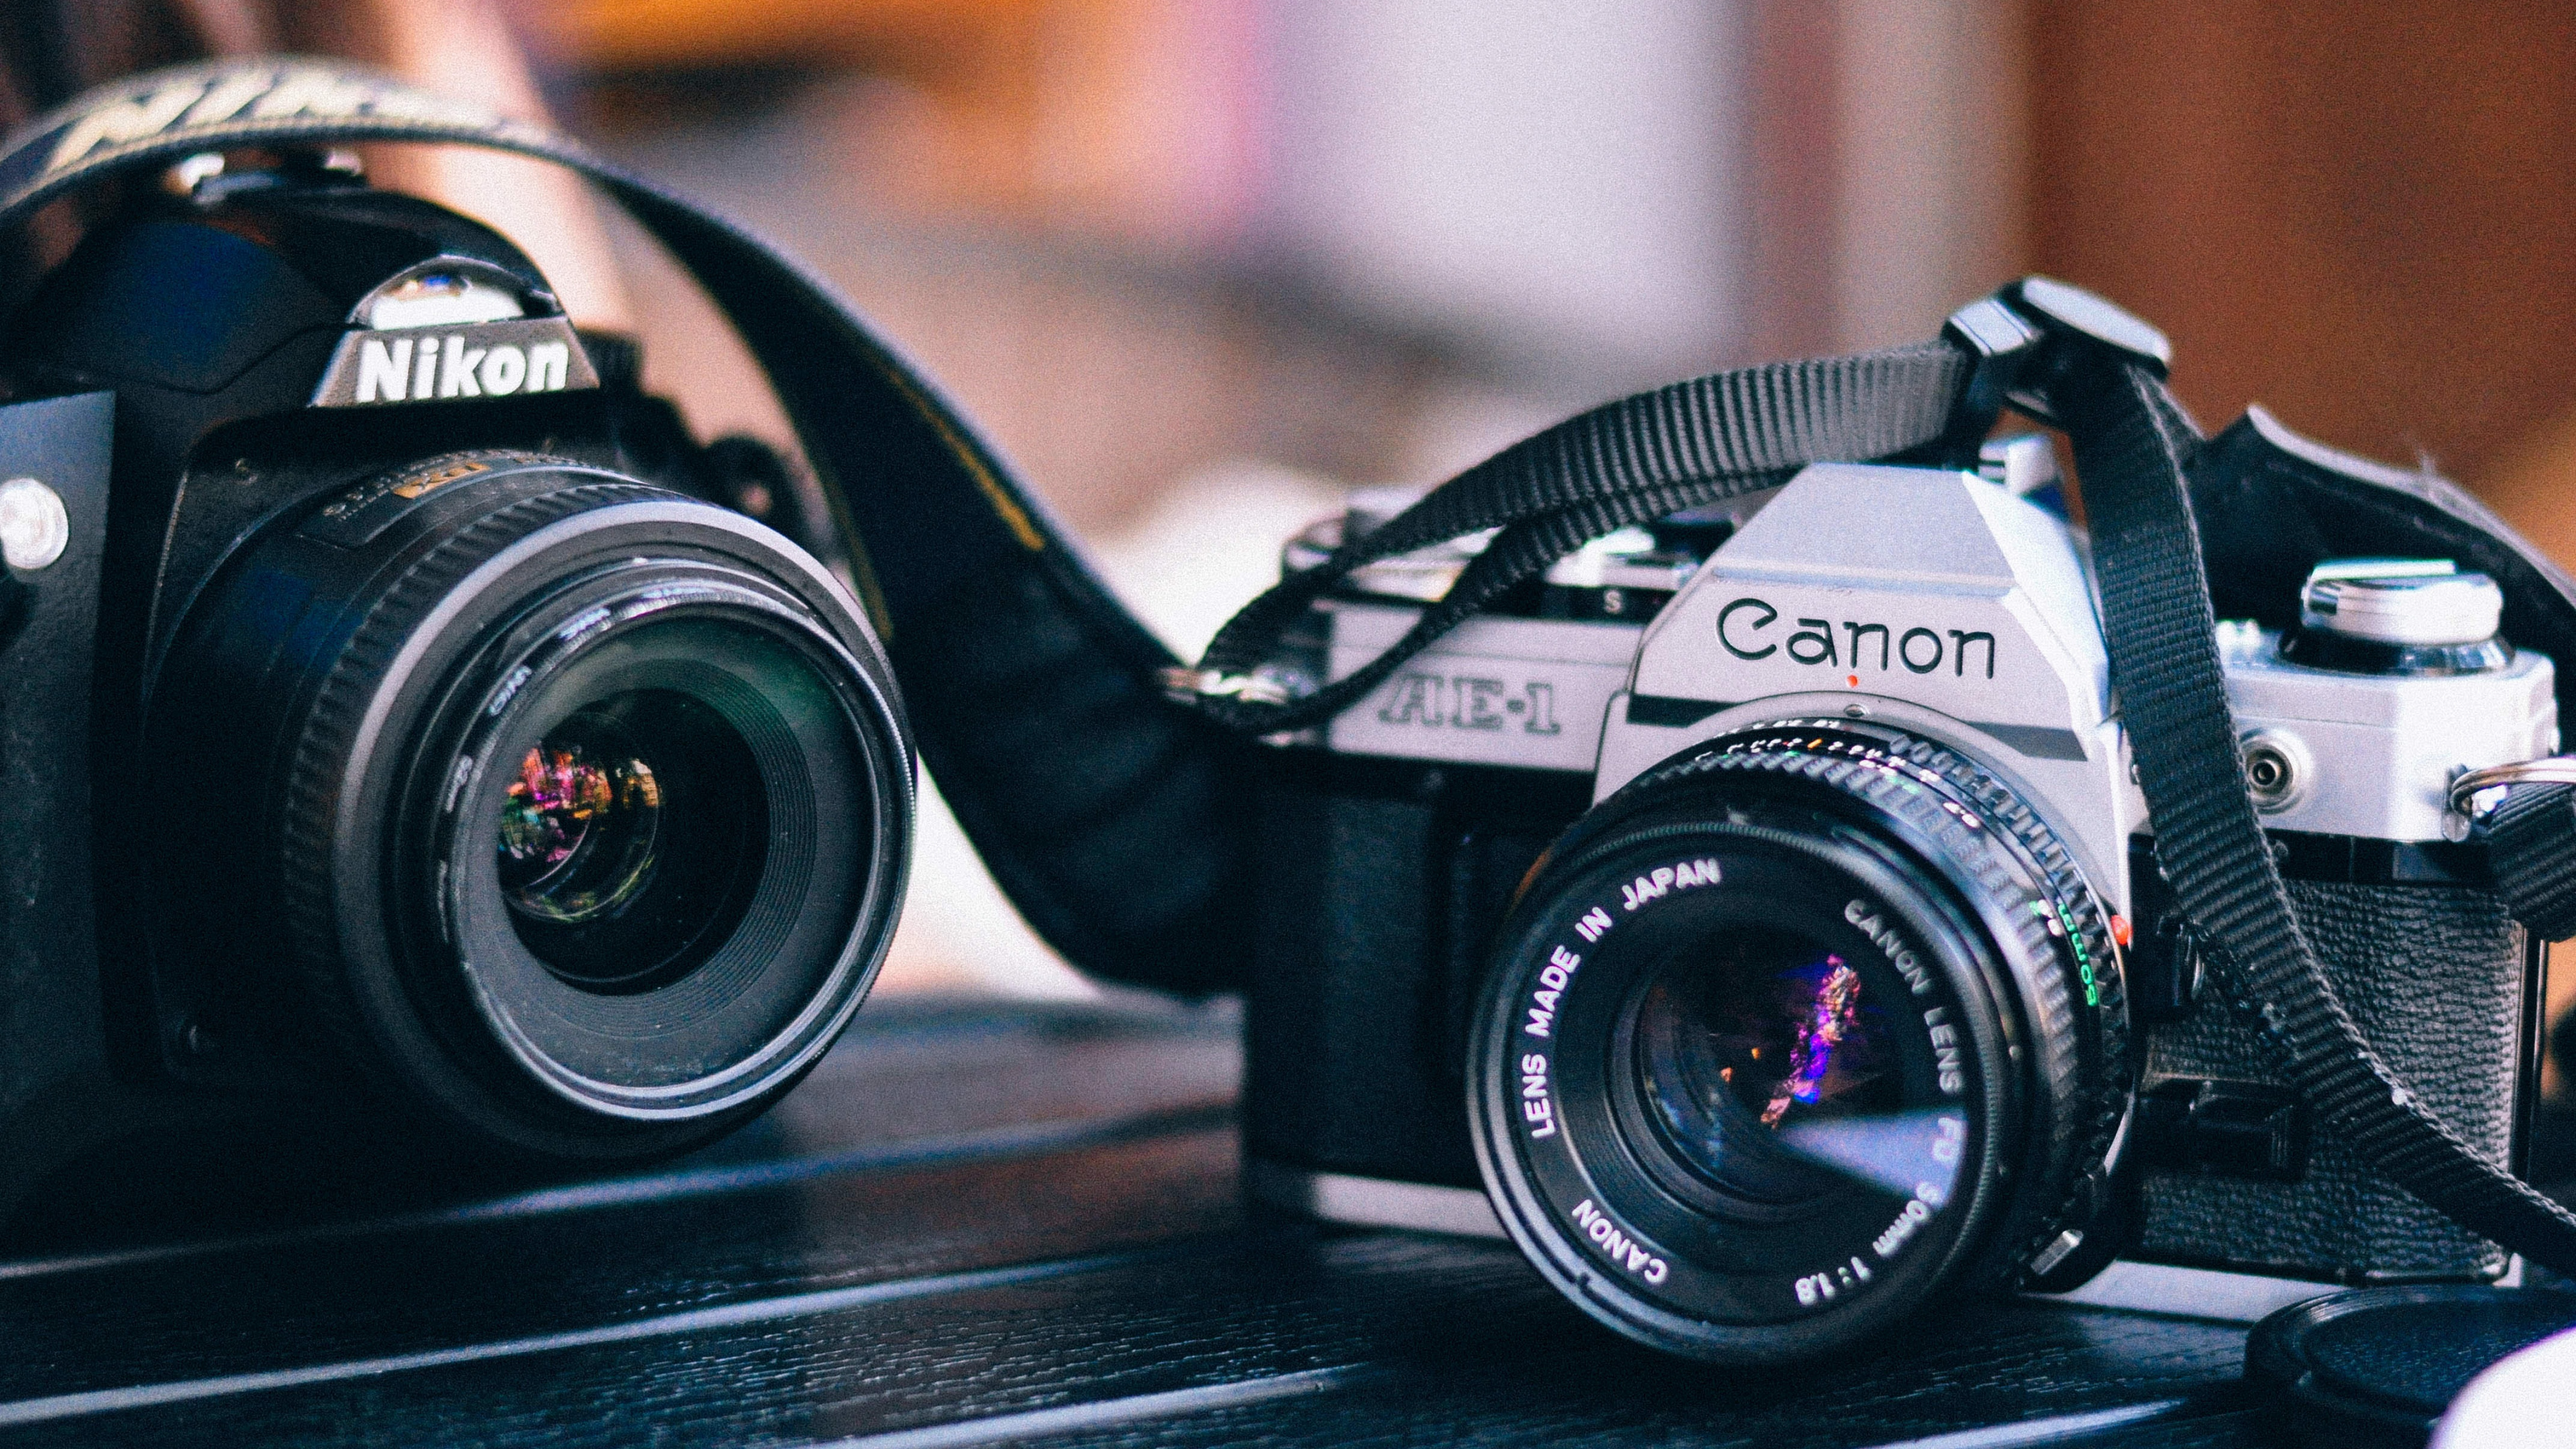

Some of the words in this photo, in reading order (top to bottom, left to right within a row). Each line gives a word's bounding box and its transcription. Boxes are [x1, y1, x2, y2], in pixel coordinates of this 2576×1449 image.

[356, 335, 569, 403] Nikon
[1605, 590, 1622, 613] S
[1717, 598, 1995, 680] Canon
[1377, 672, 1561, 736] AE-1
[1621, 857, 1722, 910] JAPAN
[1575, 906, 1613, 943] IN
[1845, 899, 1931, 995] CANON
[2057, 902, 2099, 1006] 50mm
[1525, 945, 1581, 1037] MADE
[1923, 1006, 1963, 1093] LENS
[1521, 1053, 1555, 1138] LENS
[1932, 1116, 1965, 1163] FD
[1571, 1198, 1668, 1284] CANON
[1872, 1181, 1942, 1256] 50mm
